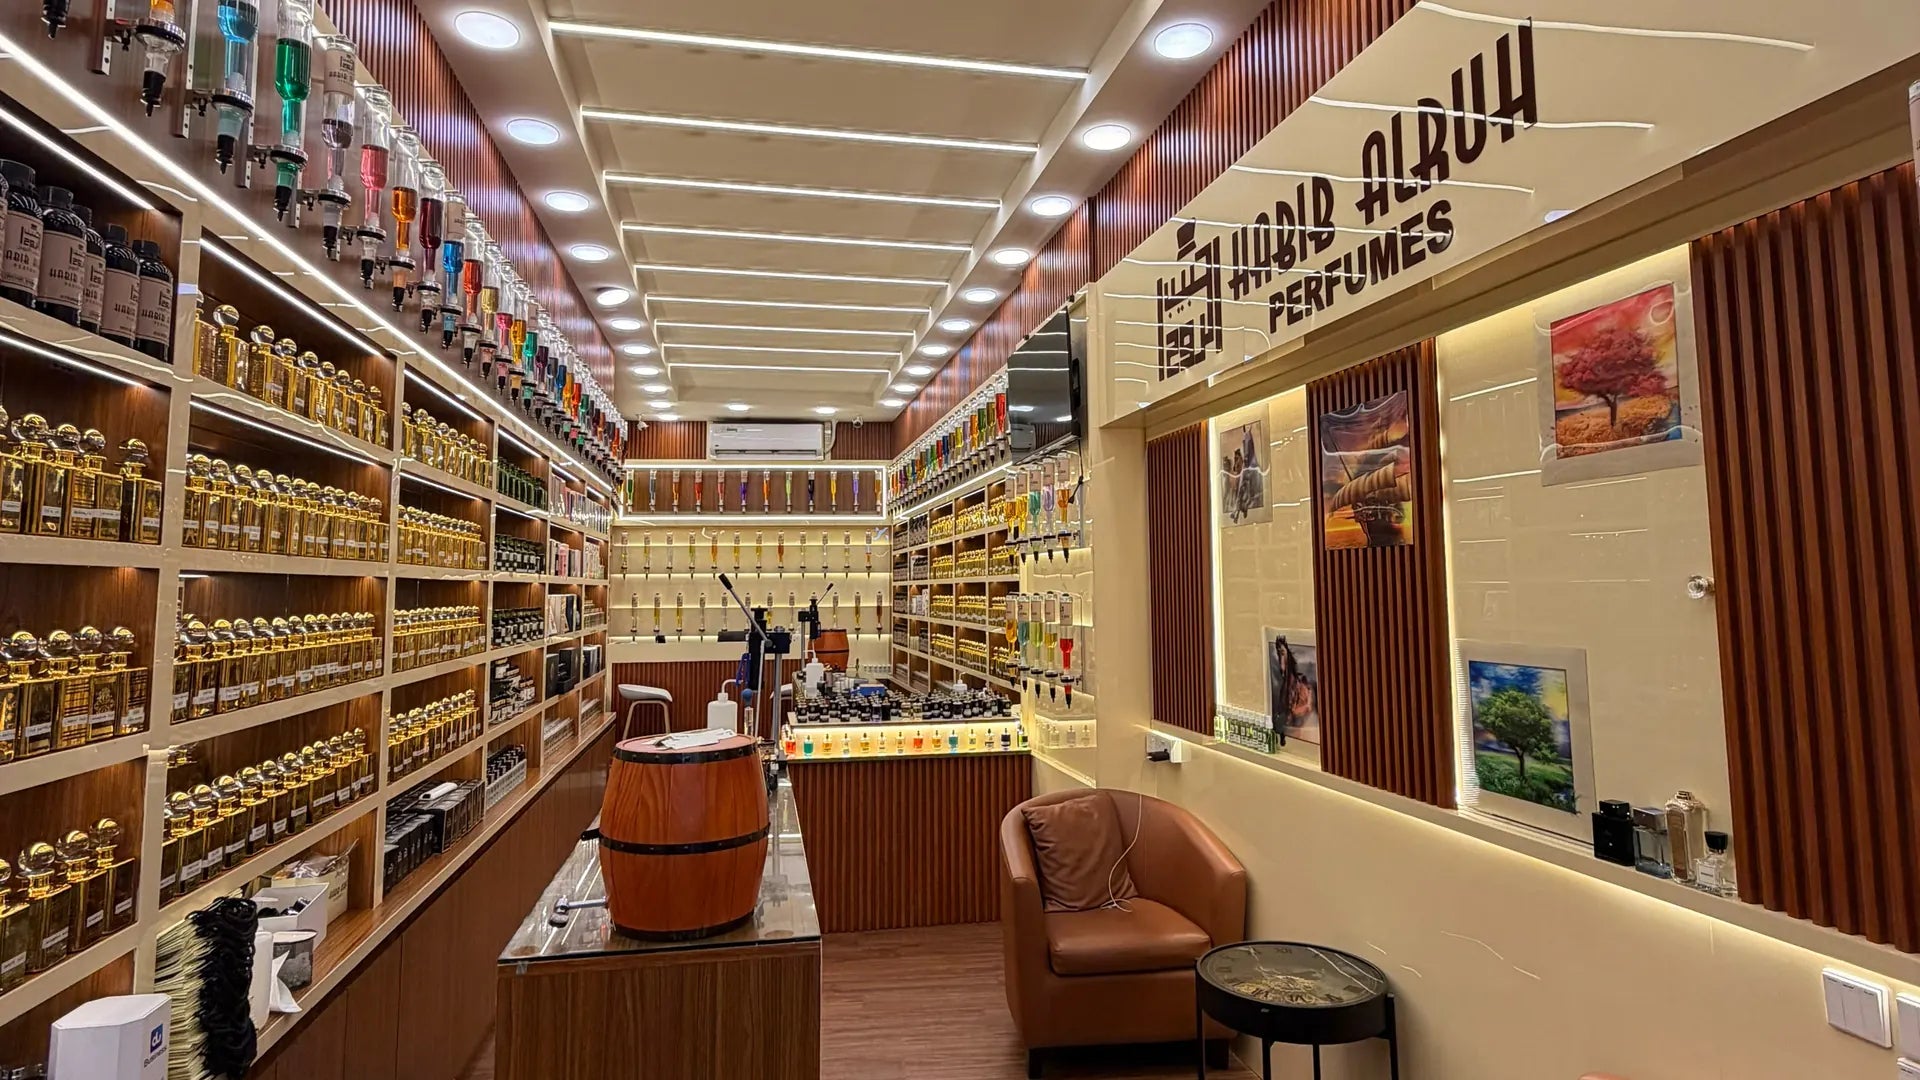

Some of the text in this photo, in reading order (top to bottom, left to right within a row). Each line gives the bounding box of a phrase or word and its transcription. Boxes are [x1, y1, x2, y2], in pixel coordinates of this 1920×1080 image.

[1228, 16, 1537, 300] HABIB ALRUH
[1269, 199, 1454, 334] PERFUMES
